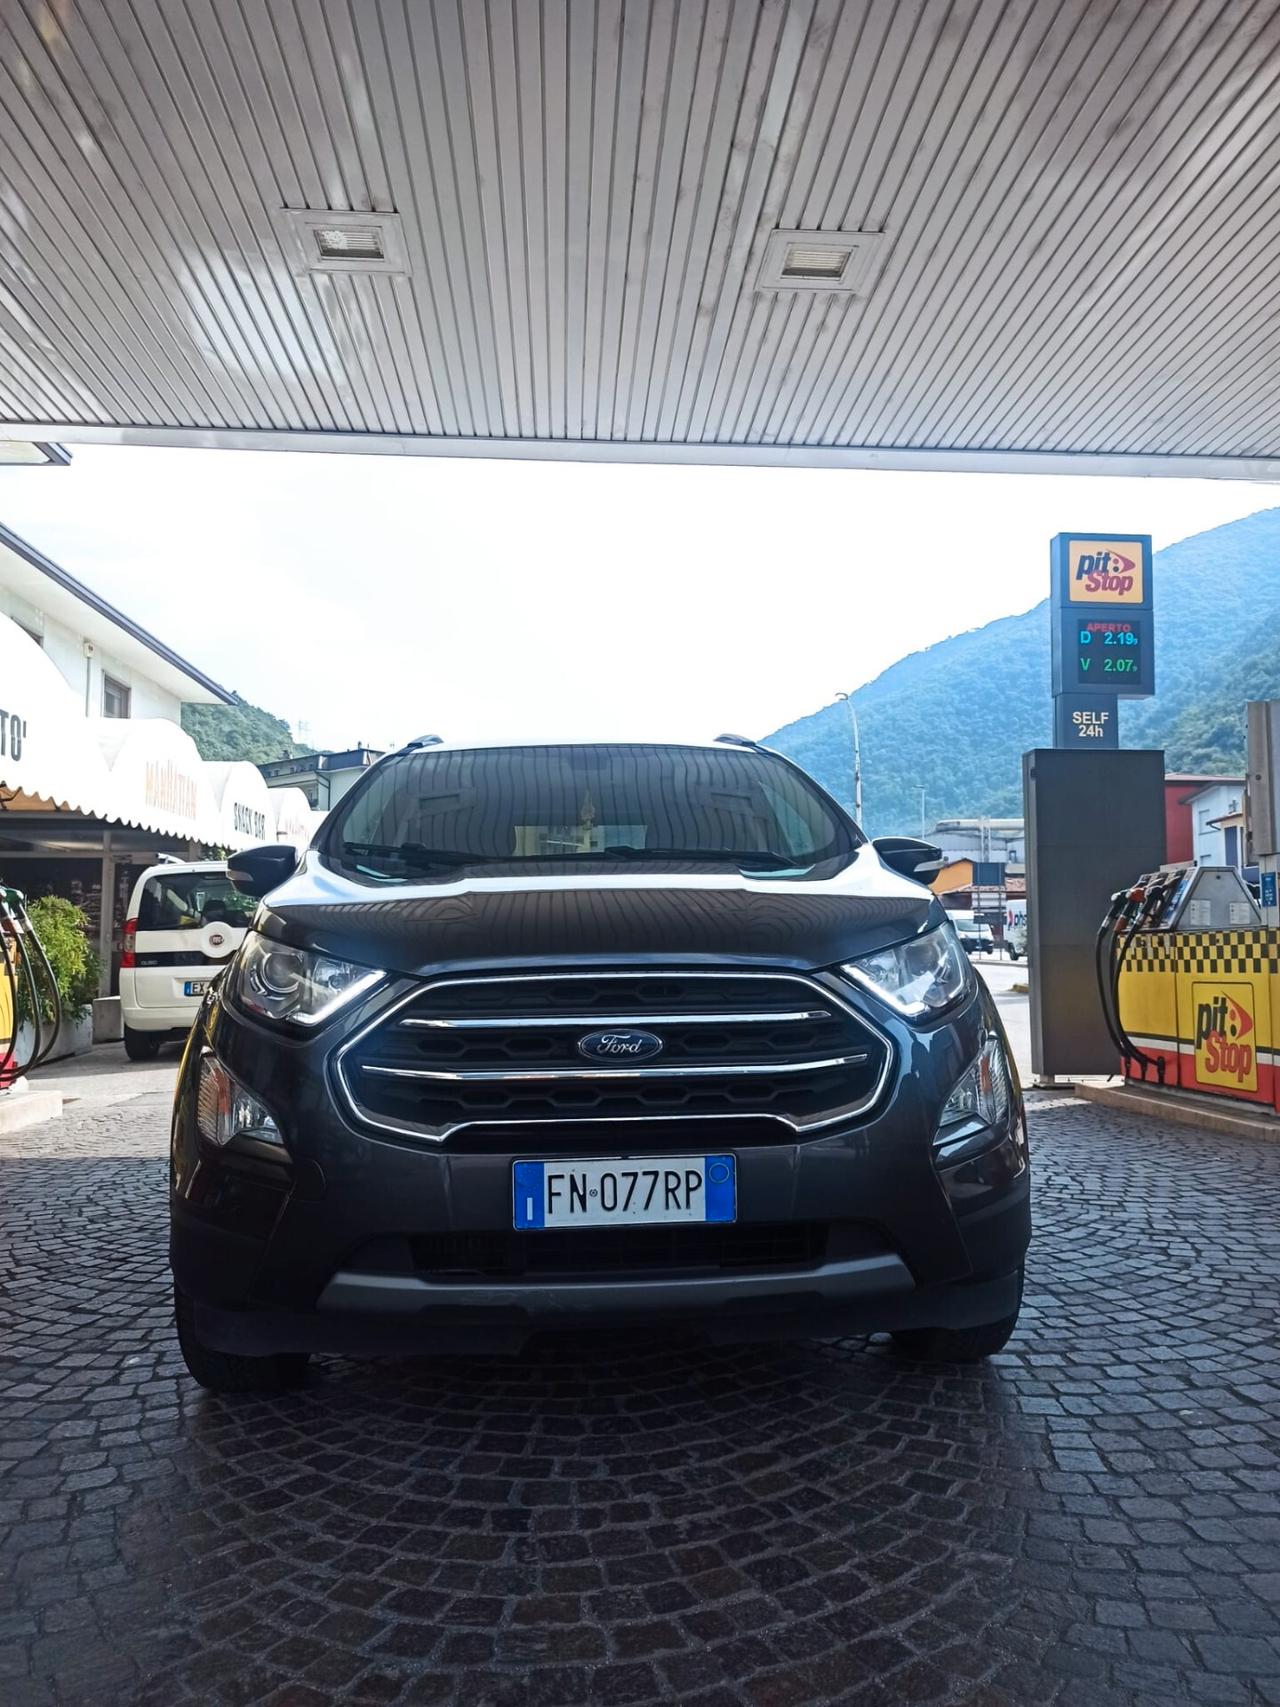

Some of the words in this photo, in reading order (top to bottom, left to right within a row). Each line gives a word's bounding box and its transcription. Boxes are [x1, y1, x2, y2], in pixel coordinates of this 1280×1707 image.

[1076, 551, 1111, 580] pit
[1085, 571, 1134, 596] Stop
[1080, 631, 1091, 644] D
[1086, 623, 1131, 632] APERTO
[1080, 658, 1090, 671] V
[1072, 711, 1109, 724] SELF
[1078, 725, 1103, 737] 24h
[234, 802, 253, 836] SNACK
[254, 811, 266, 840] BAR
[1196, 996, 1228, 1050] pit
[597, 1034, 642, 1054] Ford
[1205, 1029, 1252, 1083] Stop
